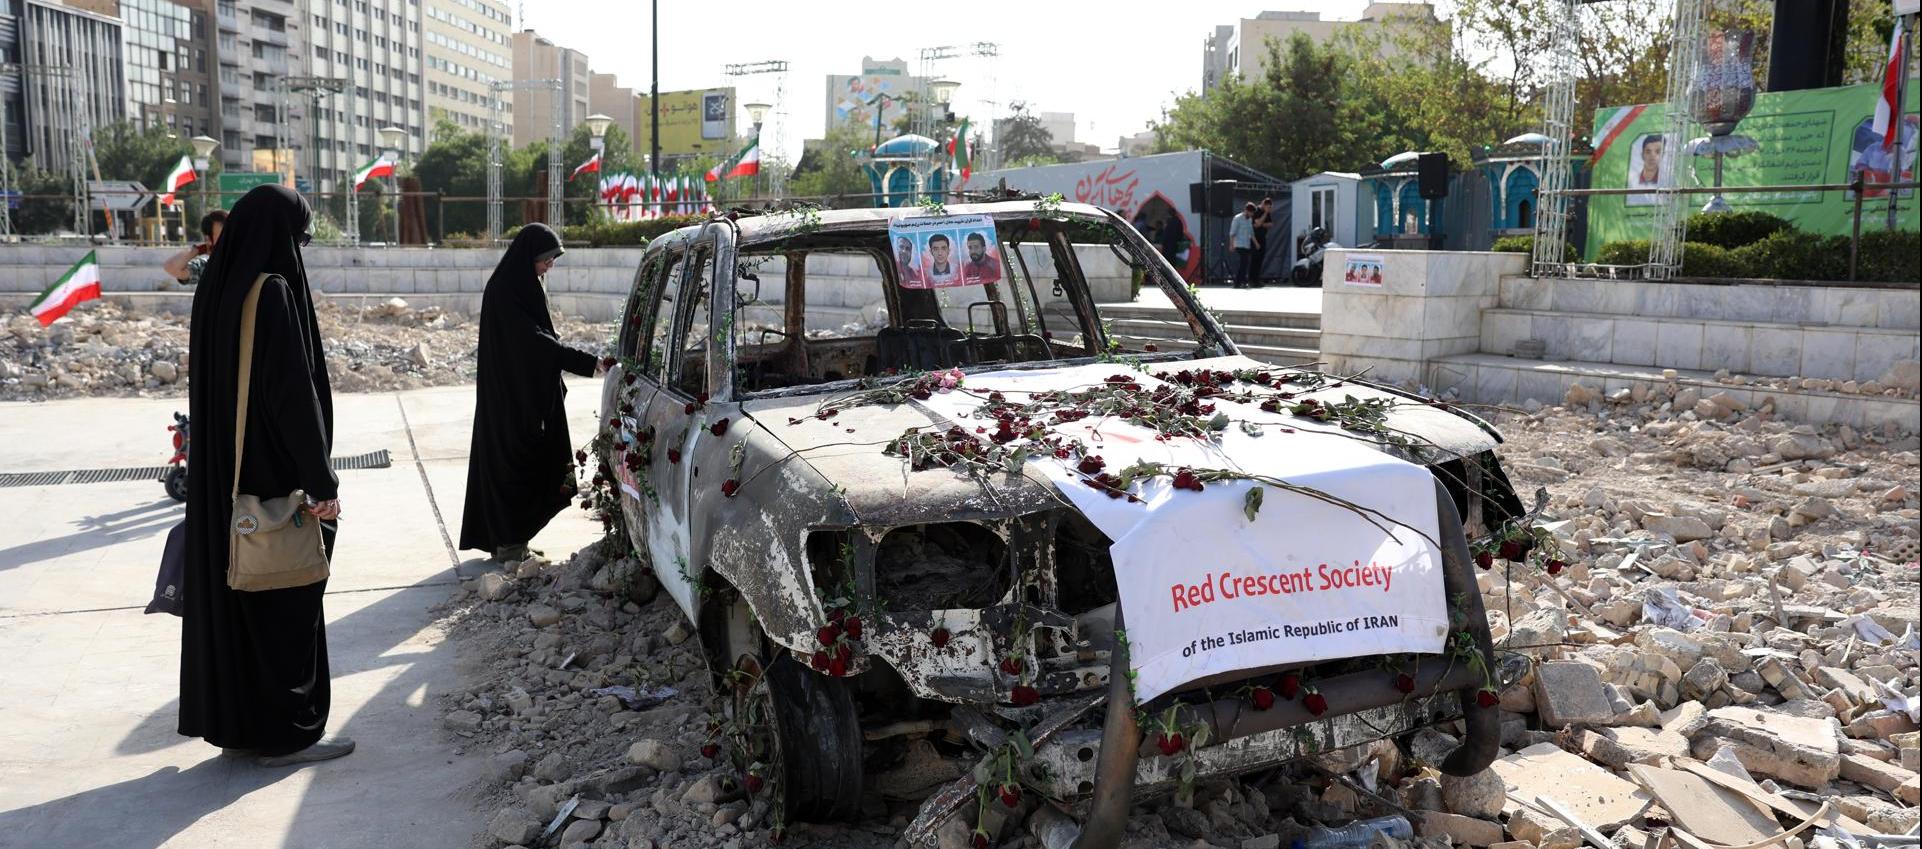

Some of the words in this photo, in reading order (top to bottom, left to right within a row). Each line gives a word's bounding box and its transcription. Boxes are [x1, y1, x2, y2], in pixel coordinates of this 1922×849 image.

[1171, 573, 1215, 613] Red
[1219, 567, 1313, 599] Crescent
[1317, 560, 1392, 592] Society
[1182, 640, 1197, 657] of
[1201, 635, 1225, 651] the
[1228, 626, 1280, 645] Islamic
[1284, 620, 1343, 639] Republic
[1346, 618, 1359, 632] of
[1364, 615, 1398, 630] IRAN
